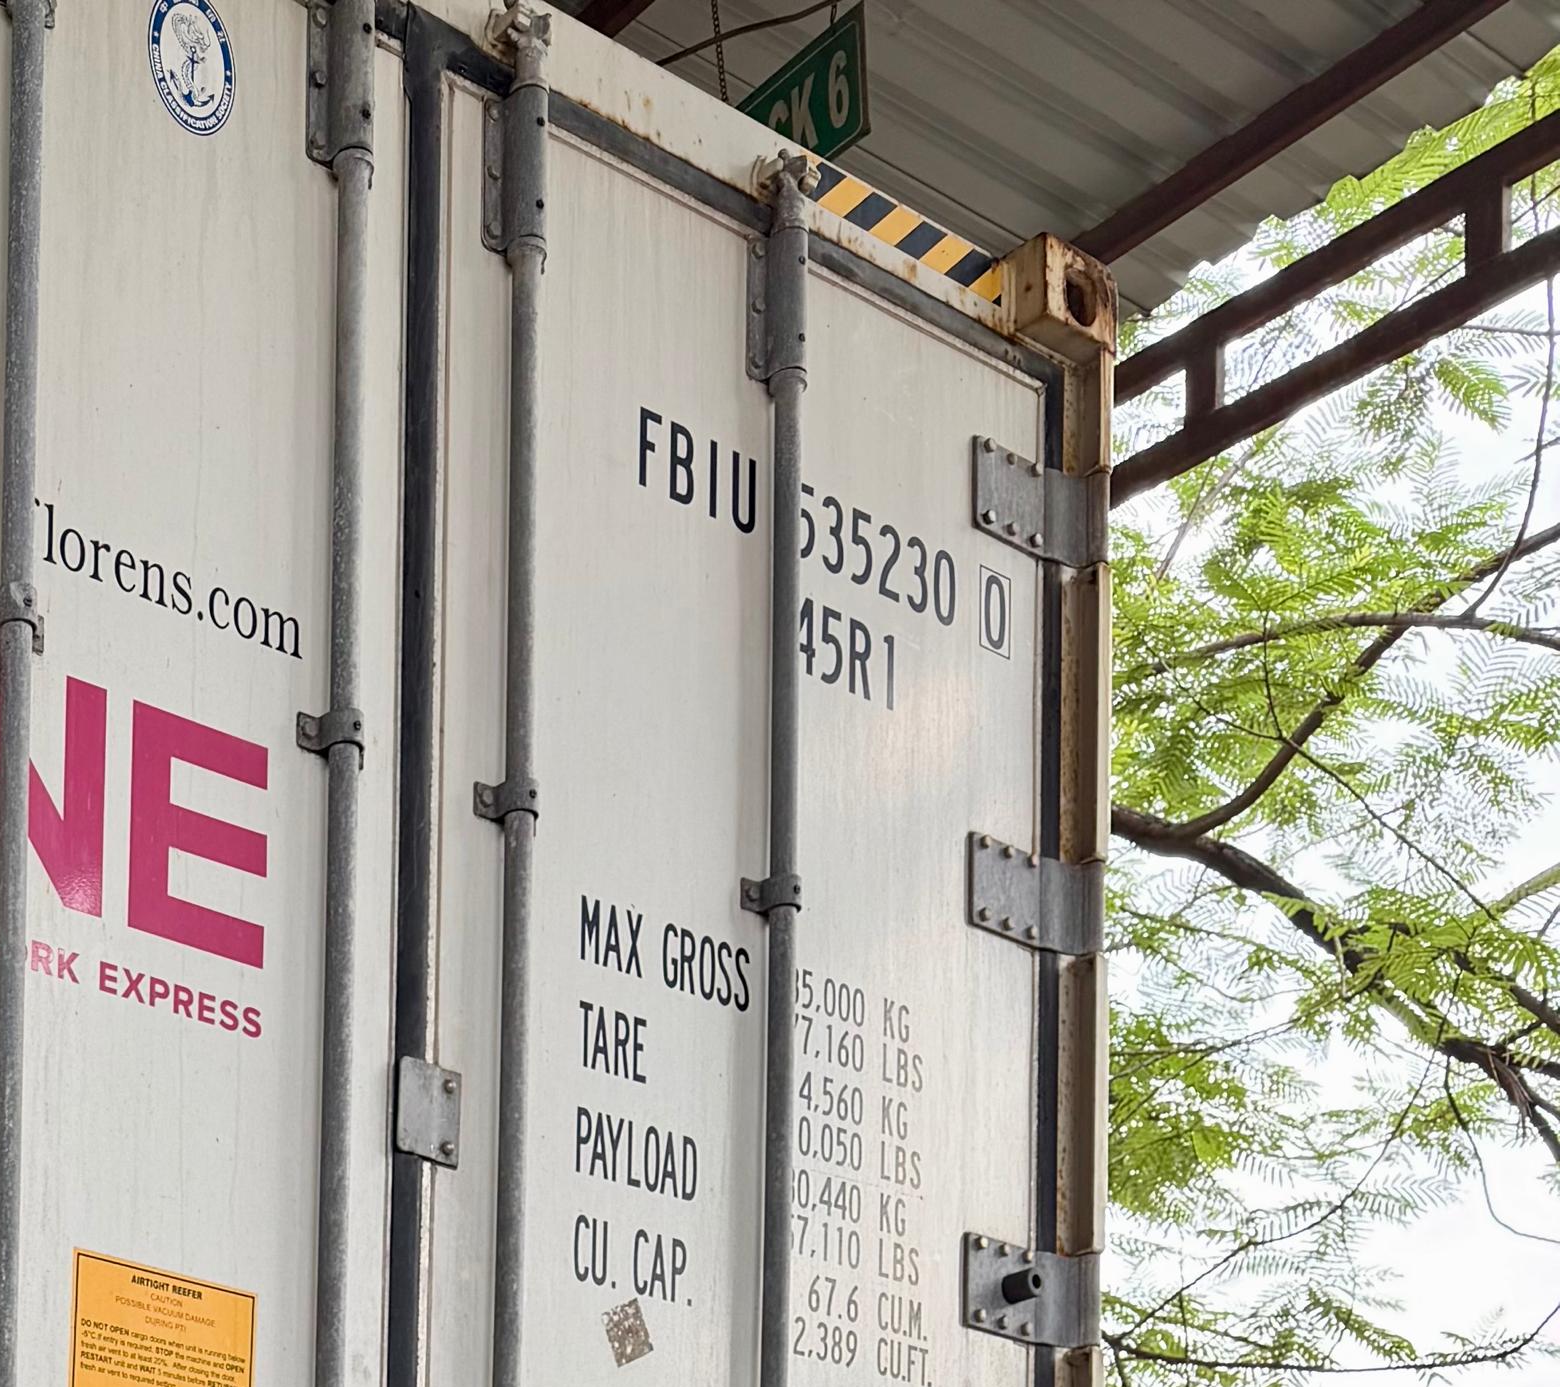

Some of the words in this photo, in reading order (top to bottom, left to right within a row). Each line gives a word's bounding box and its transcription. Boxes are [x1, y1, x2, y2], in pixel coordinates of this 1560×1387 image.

[152, 44, 163, 78] CHINA
[159, 81, 218, 129] CLASSIFICATION
[216, 82, 232, 119] SOCIETY
[829, 50, 850, 129] 6
[638, 405, 757, 535] FBIU
[799, 483, 956, 627] 535230
[983, 573, 1008, 651] 0
[799, 597, 896, 711] 45R1
[580, 894, 643, 979] MAX
[662, 922, 750, 1012] GROSS
[97, 960, 264, 1039] EXPRESS
[883, 997, 910, 1044] KG
[580, 1000, 648, 1084] TARE
[794, 1013, 865, 1073] 7,160
[882, 1043, 923, 1093] LBS
[799, 1071, 864, 1126] 4,560
[881, 1095, 908, 1140] KG
[575, 1106, 698, 1201] PAYLOAD
[880, 1140, 922, 1190] LBS
[792, 1168, 862, 1224] 0,440
[879, 1192, 907, 1238] KG
[131, 1274, 169, 1291] AIRTIGHT
[172, 1284, 202, 1300] REEFER
[574, 1214, 617, 1289] CU.
[633, 1228, 693, 1307] CAP.
[878, 1238, 920, 1287] LBS
[115, 1295, 150, 1311] POSSIBLE
[153, 1304, 183, 1319] VACUUM
[185, 1312, 215, 1327] DAMAGE
[144, 1315, 173, 1329] DURING
[150, 1292, 182, 1307] CAUTION
[808, 1274, 859, 1324] 67.6
[877, 1292, 928, 1342] CU.M.
[80, 1350, 111, 1364] RESTART
[139, 1364, 155, 1374] WAIT
[81, 1318, 91, 1327] DO
[93, 1321, 107, 1331] NOT
[109, 1325, 129, 1336] OPEN
[131, 1330, 148, 1341] cargo
[149, 1334, 166, 1345] doors
[168, 1339, 183, 1349] when
[185, 1343, 196, 1352] unit
[204, 1347, 226, 1359] running
[103, 1334, 118, 1344] entry
[154, 1346, 173, 1357] STOP
[225, 1363, 244, 1374] OPEN
[793, 1316, 858, 1369] 2,389
